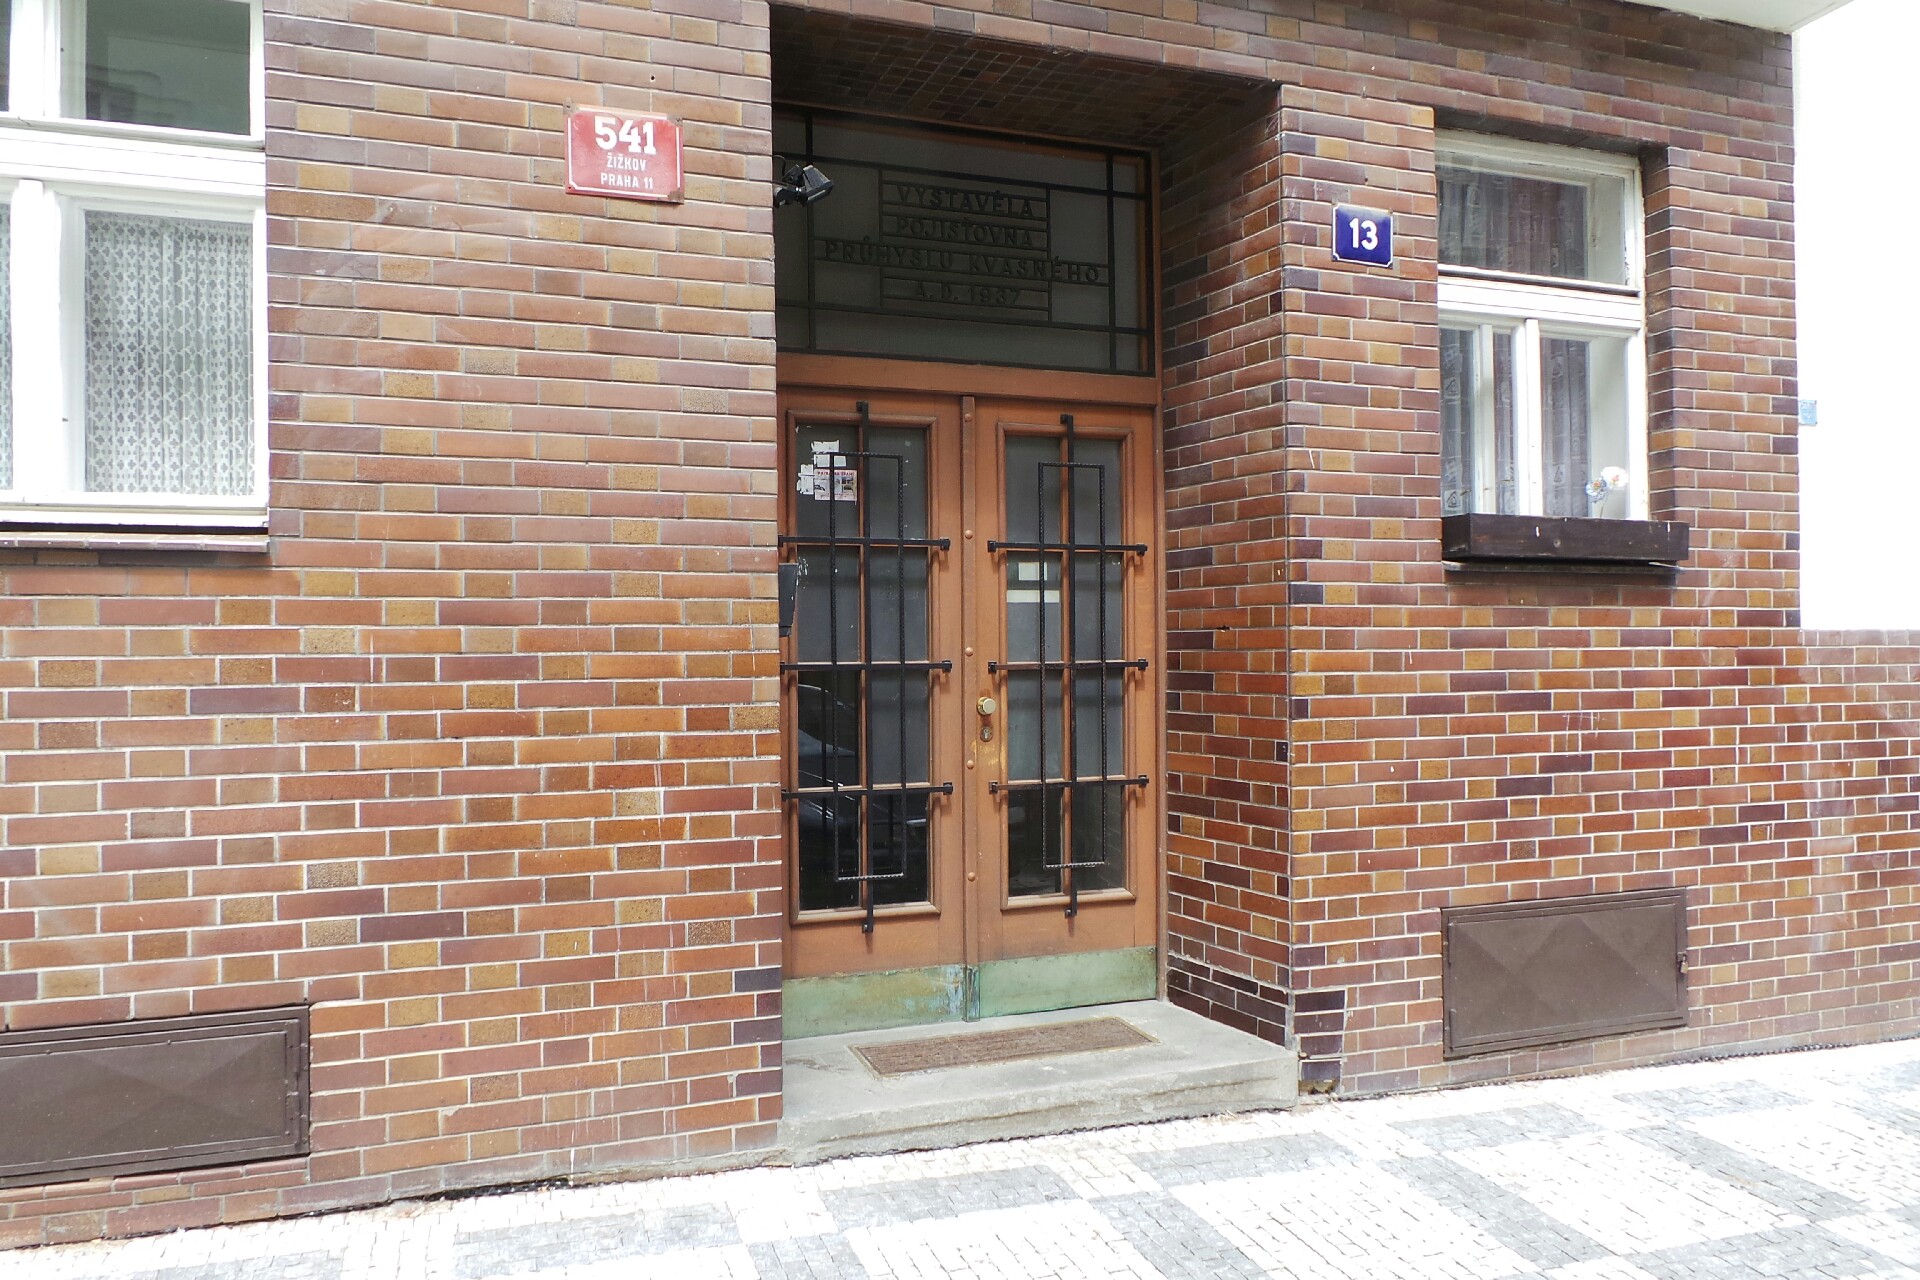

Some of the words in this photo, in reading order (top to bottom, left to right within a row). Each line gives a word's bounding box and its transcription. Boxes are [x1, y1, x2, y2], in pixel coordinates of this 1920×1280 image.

[594, 115, 656, 155] 541
[607, 153, 647, 171] ŽIŽKOV
[600, 172, 639, 188] PRAHA
[643, 177, 654, 189] 11
[1349, 217, 1379, 250] 13
